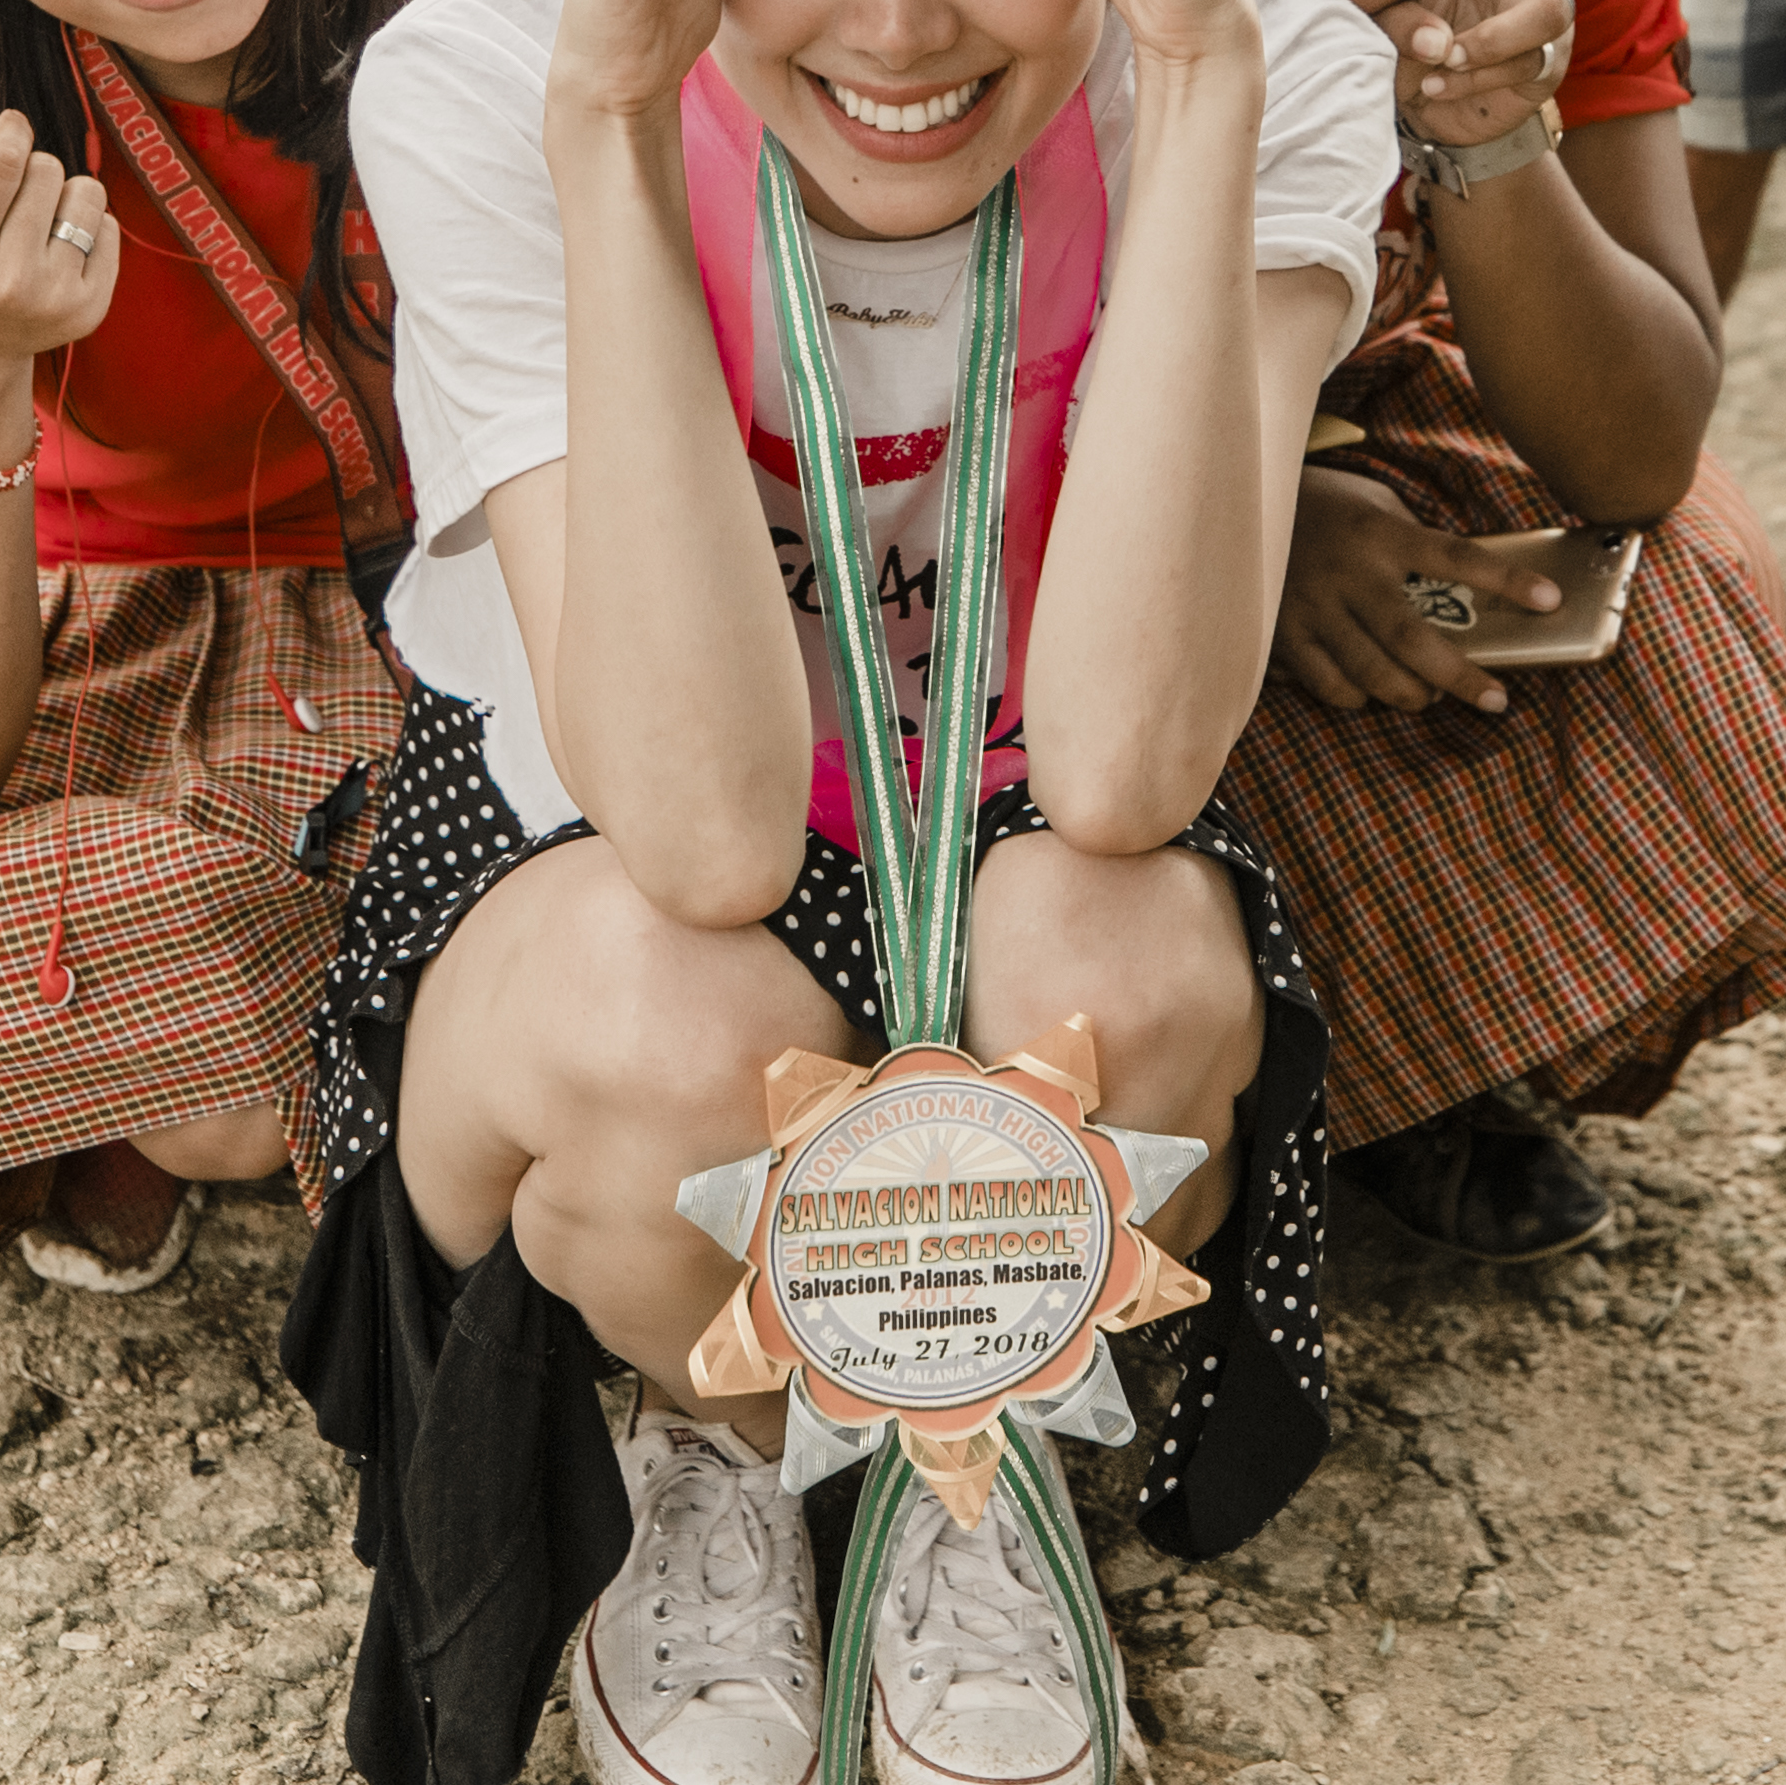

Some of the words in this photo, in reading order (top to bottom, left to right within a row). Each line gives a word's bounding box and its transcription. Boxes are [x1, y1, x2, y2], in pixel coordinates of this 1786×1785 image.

[75, 27, 191, 195] SALVACION
[166, 184, 288, 340] NATIONAL
[266, 323, 339, 411] HIGH
[850, 1093, 994, 1148] NATIONAL
[999, 1108, 1065, 1170] HIGH
[780, 1184, 940, 1235] SALVACION
[948, 1177, 1092, 1222] NATIONAL
[806, 1239, 908, 1273] HIGH
[919, 1229, 1075, 1263] SCHOOL
[788, 1274, 896, 1302] Salvacion,
[900, 1266, 988, 1291] Palanas,
[992, 1261, 1087, 1285] Masbate,
[878, 1305, 997, 1332] Philippines
[829, 1346, 899, 1373] July
[973, 1331, 1051, 1356] 2018
